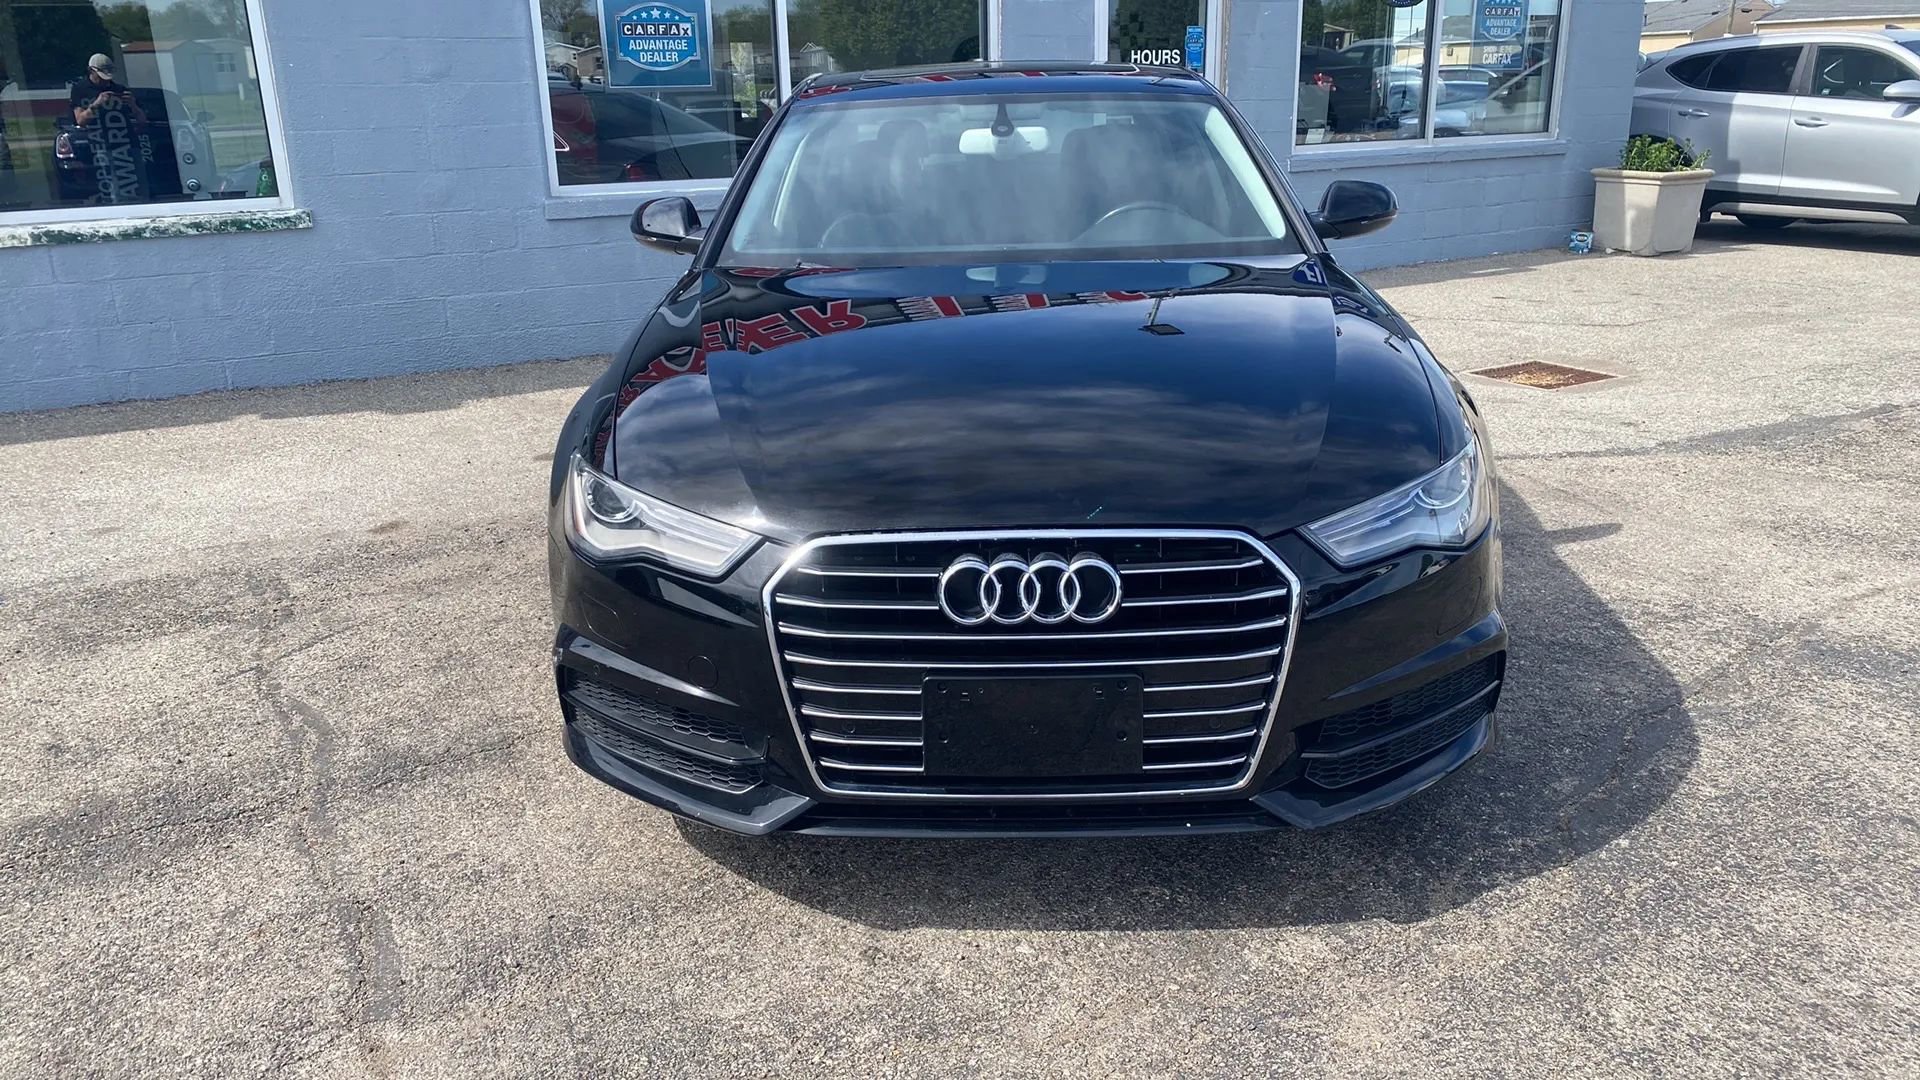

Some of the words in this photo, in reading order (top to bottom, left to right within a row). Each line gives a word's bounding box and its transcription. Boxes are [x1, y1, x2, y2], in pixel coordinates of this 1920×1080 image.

[1485, 7, 1520, 16] CARFAX
[623, 24, 691, 36] CARFAX
[1490, 27, 1511, 35] DEALER
[629, 39, 688, 50] ADVANTAGE
[640, 52, 679, 62] DEALER
[1130, 49, 1181, 65] HOURS
[1482, 53, 1513, 65] CARFAX
[102, 96, 140, 198] AWARDS
[138, 134, 154, 162] 2025
